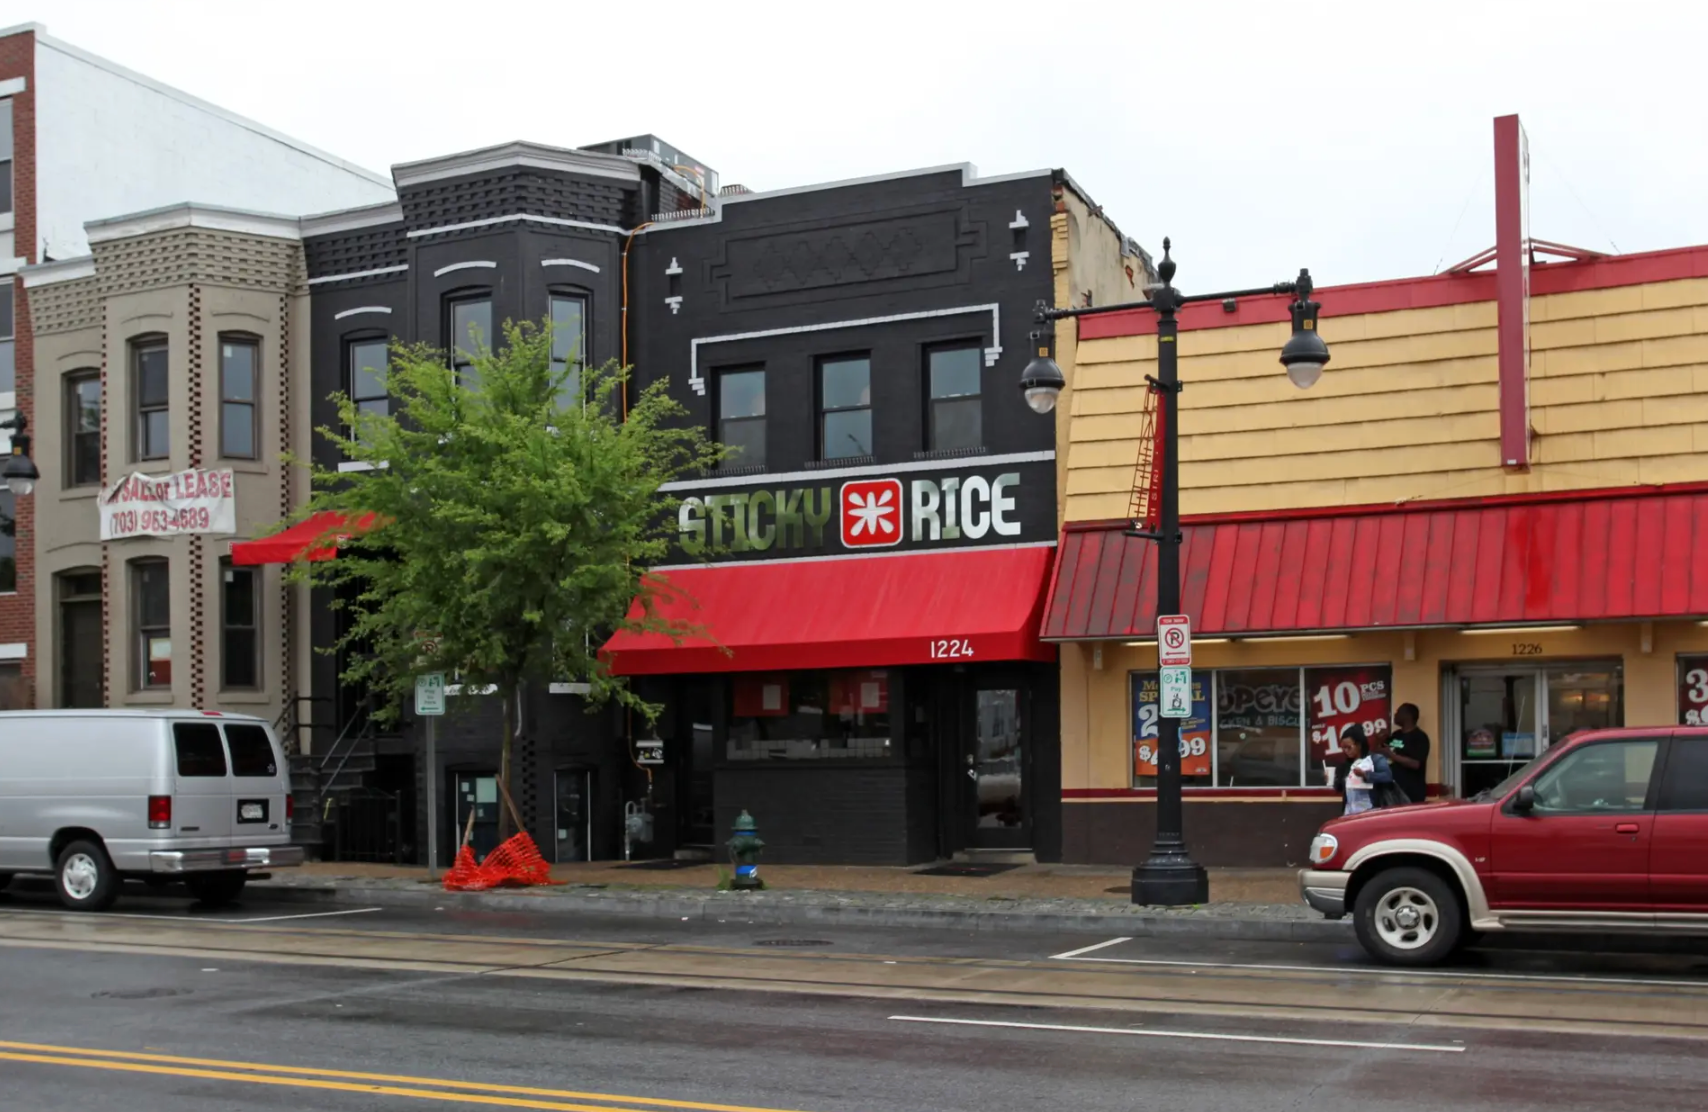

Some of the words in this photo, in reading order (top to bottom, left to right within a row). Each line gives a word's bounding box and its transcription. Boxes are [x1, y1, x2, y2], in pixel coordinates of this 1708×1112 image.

[176, 471, 232, 499] LEASE
[110, 510, 138, 536] (703)
[679, 487, 831, 556] STICKY
[911, 472, 1021, 541] RICE
[930, 638, 974, 659] 1224
[1512, 642, 1543, 655] 1226
[1313, 681, 1360, 718] 10
[1360, 680, 1385, 693] PCS
